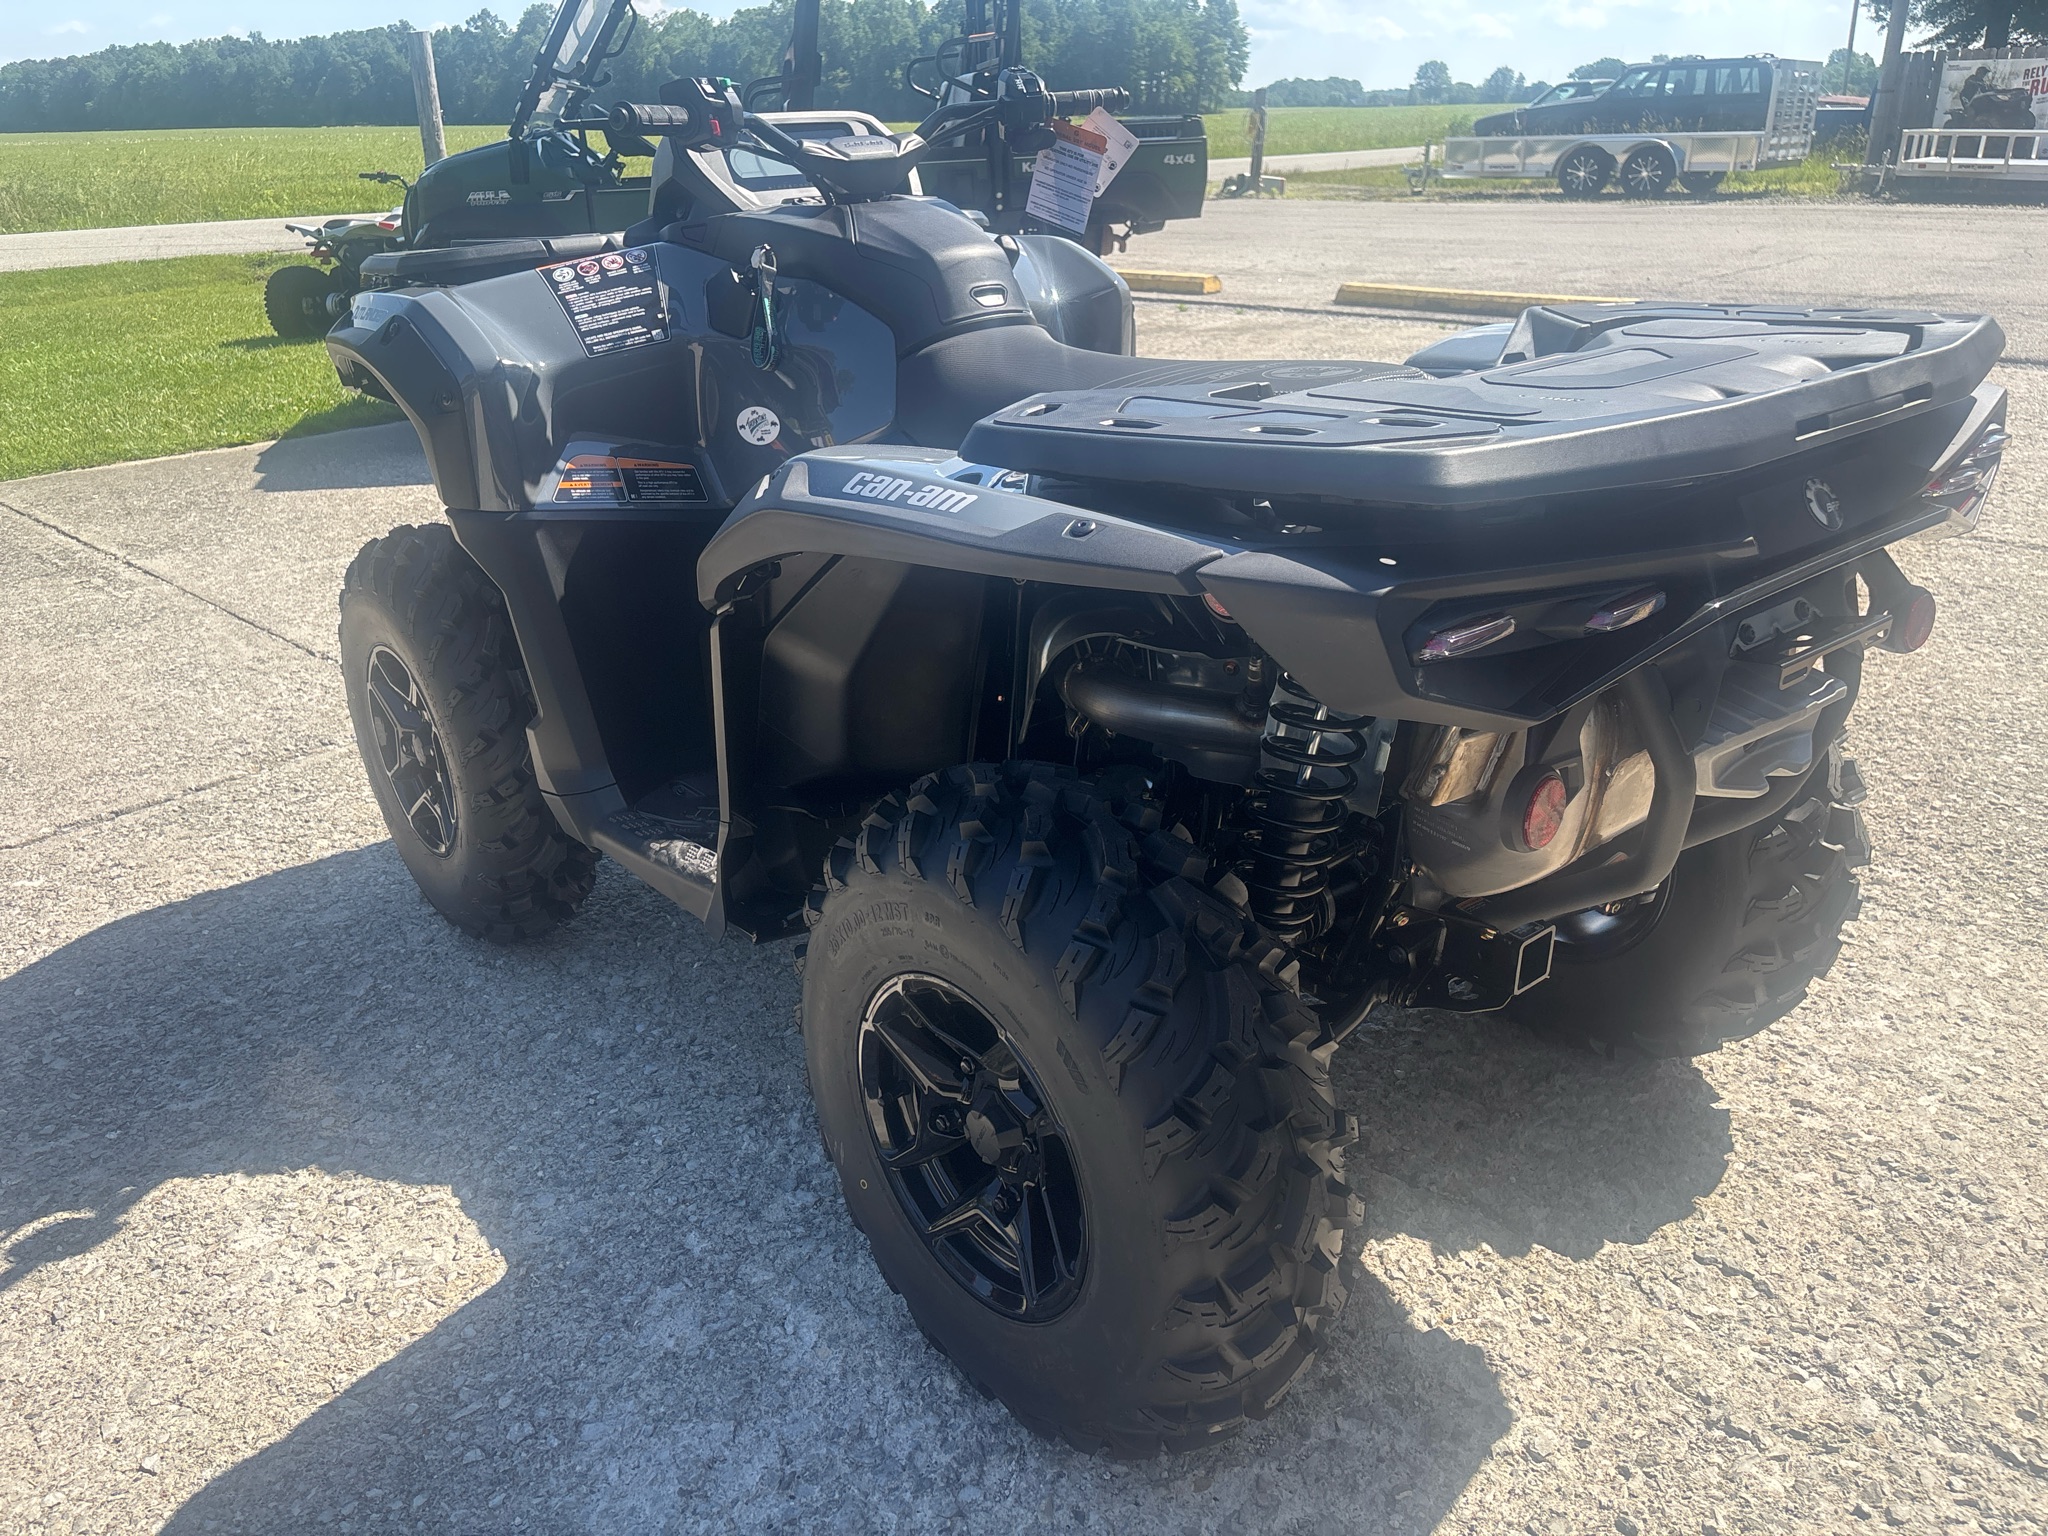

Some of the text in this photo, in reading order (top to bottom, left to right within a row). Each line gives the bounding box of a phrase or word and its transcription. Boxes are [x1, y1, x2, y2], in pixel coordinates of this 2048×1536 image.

[2023, 65, 2048, 80] RELY
[1163, 153, 1197, 165] 4x4
[842, 471, 979, 514] can-am
